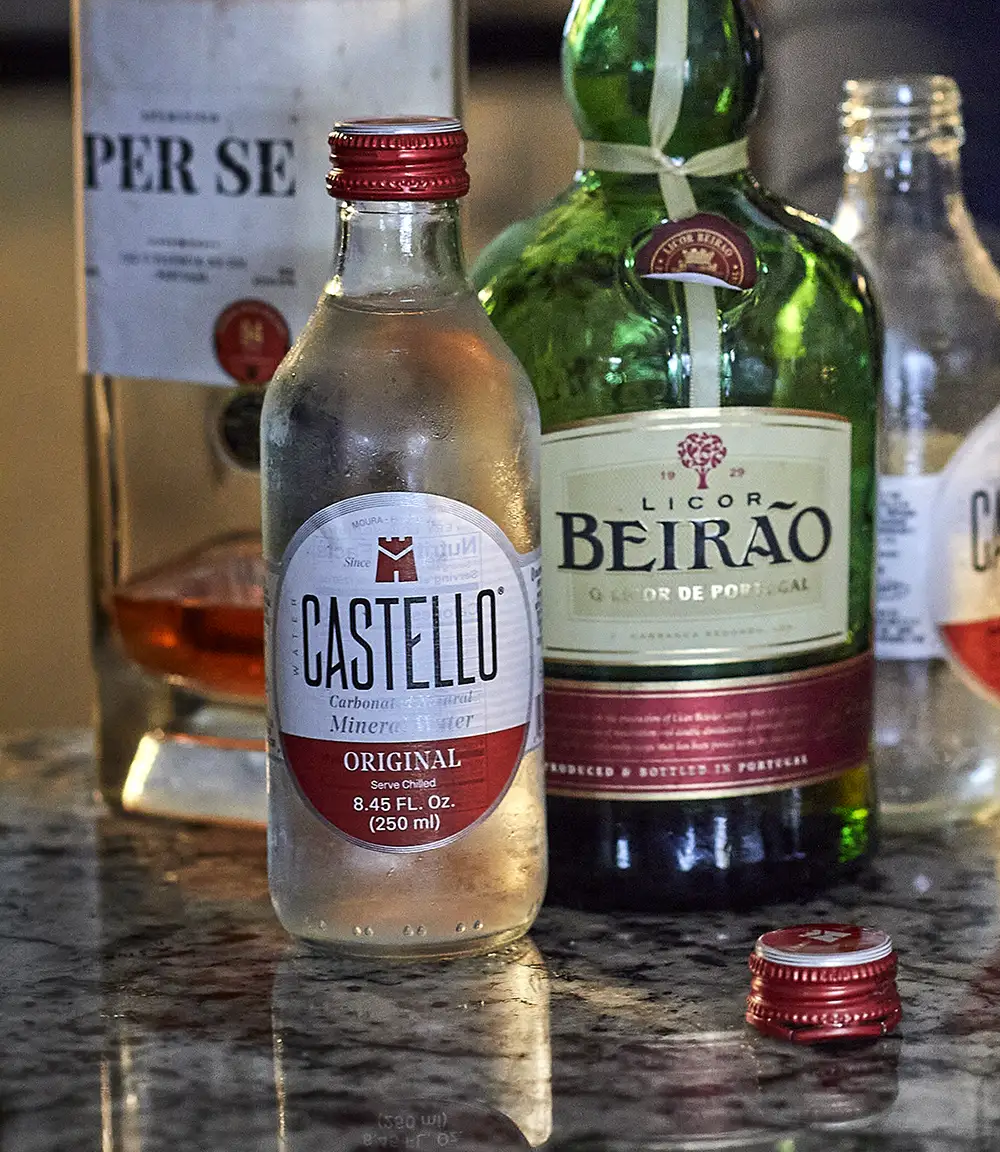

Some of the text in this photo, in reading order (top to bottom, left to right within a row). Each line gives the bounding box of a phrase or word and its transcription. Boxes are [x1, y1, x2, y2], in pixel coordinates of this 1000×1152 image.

[84, 132, 296, 197] PER SE
[642, 492, 762, 511] LICOR
[352, 516, 383, 529] MOURA
[556, 501, 833, 572] BEIRÃO
[343, 556, 371, 569] Since
[678, 585, 704, 601] DE
[711, 577, 809, 599] PORTGAL
[292, 599, 300, 676] WATER
[329, 715, 406, 734] Minera
[343, 748, 461, 772] ORIGINAL
[370, 778, 437, 790] Serve Chilled
[353, 794, 456, 811] 8.45 FL. Oz.
[369, 813, 441, 833] (250 ml)
